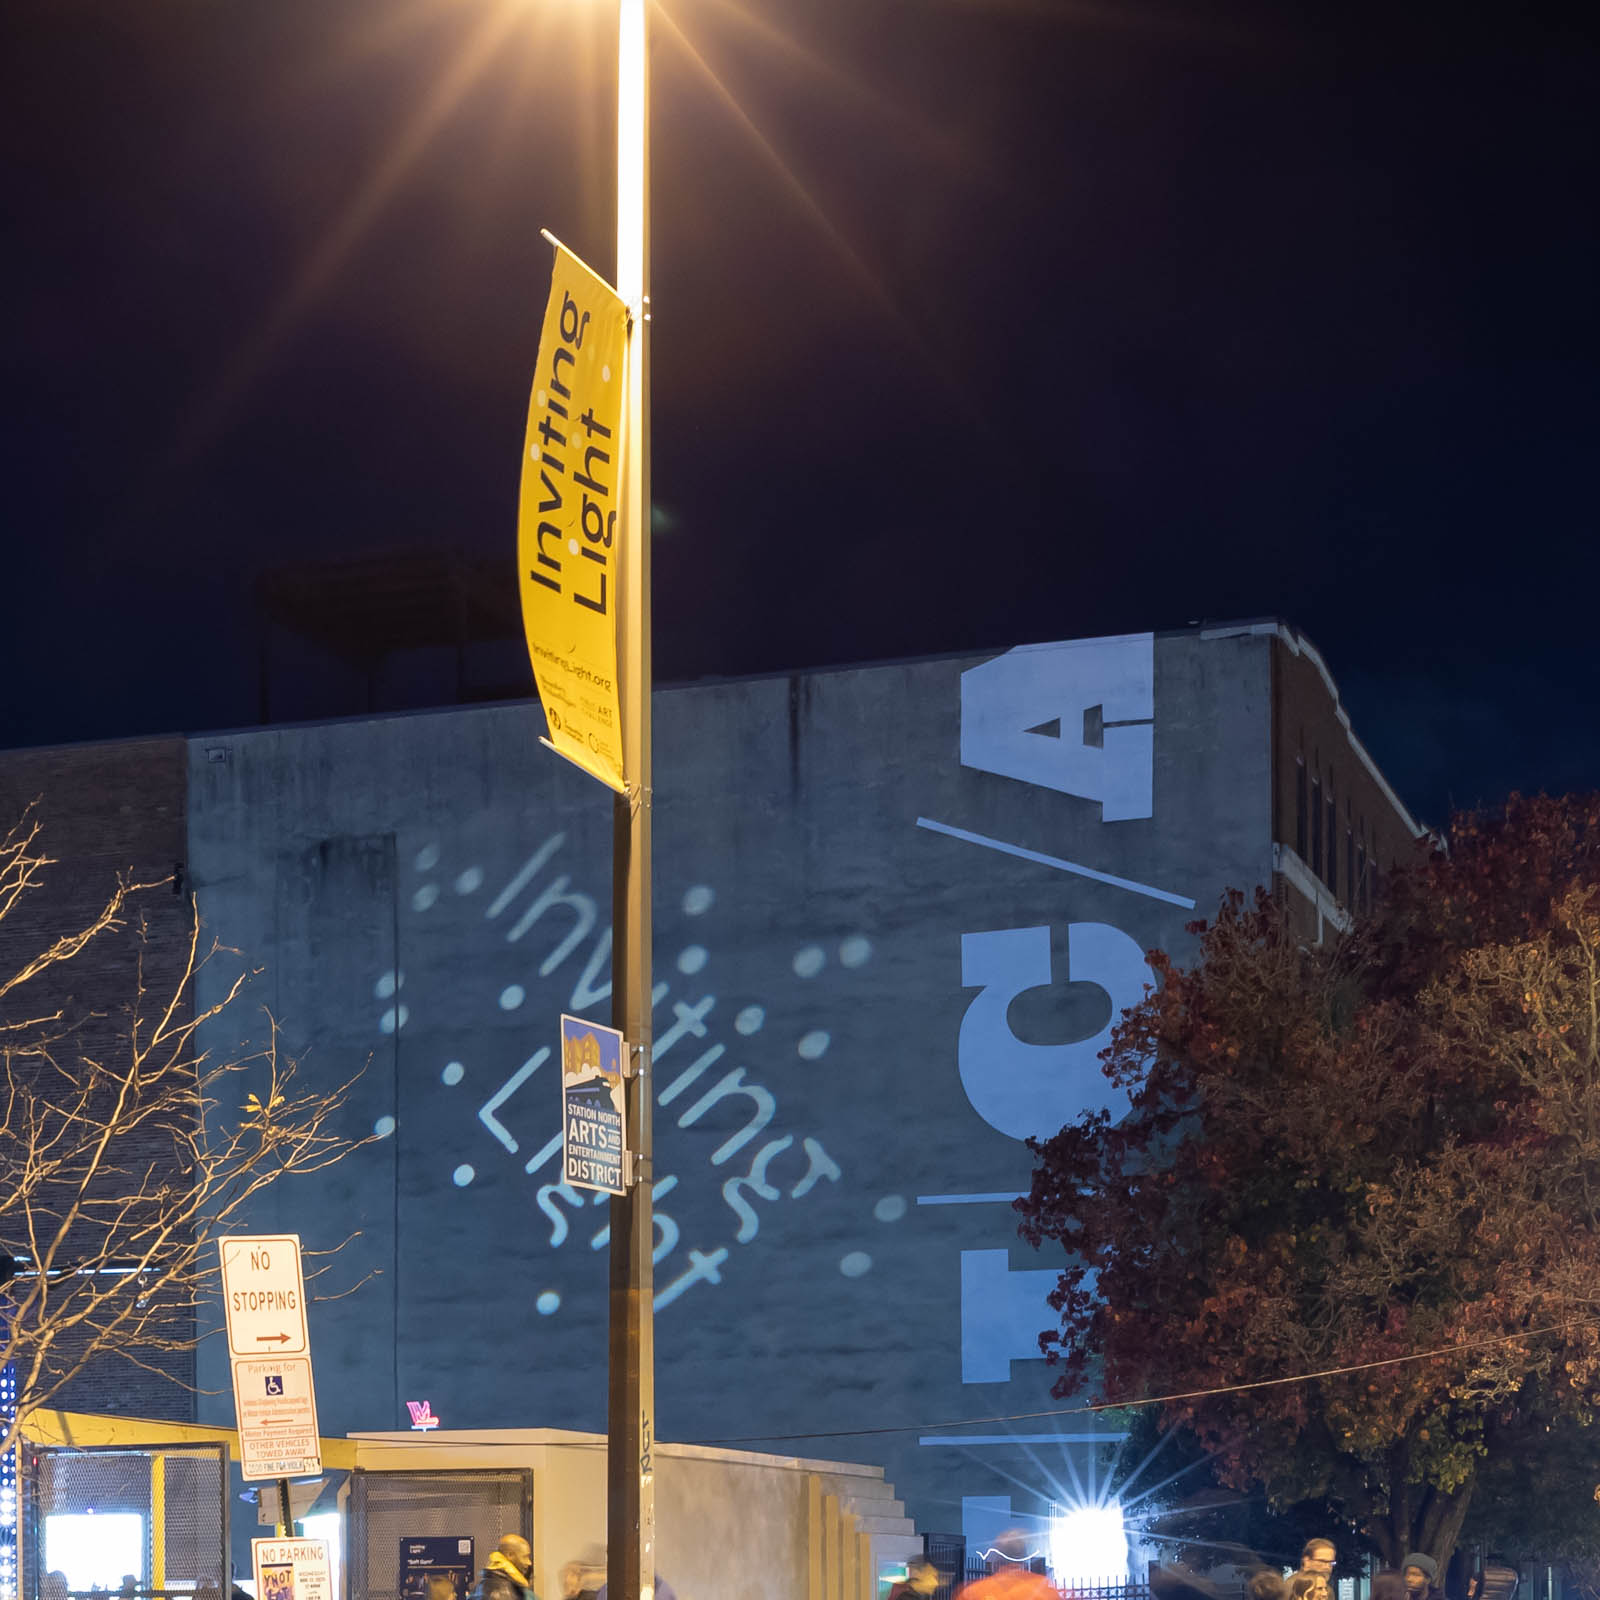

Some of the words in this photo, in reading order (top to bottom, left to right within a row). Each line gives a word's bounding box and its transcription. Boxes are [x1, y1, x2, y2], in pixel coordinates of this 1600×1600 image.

[530, 290, 591, 594] Inviting
[573, 407, 617, 616] Light
[486, 832, 842, 1243] Invting
[568, 1103, 597, 1120] STATION
[598, 1111, 620, 1127] NORTH
[568, 1118, 607, 1149] ARTS
[568, 1145, 621, 1165] ENTERTAINMENT
[568, 1157, 621, 1187] DISTRICT
[251, 1251, 270, 1271] NO
[233, 1291, 296, 1312] STOPPING
[248, 1363, 281, 1374] Parking
[283, 1362, 297, 1371] for
[250, 1441, 275, 1450] OTHER
[277, 1439, 310, 1449] VEHICLES
[256, 1449, 283, 1458] TOWED
[284, 1447, 306, 1456] AWAY
[262, 1548, 276, 1562] NO
[280, 1546, 324, 1561] PARKING
[264, 1570, 291, 1587] YNOT
